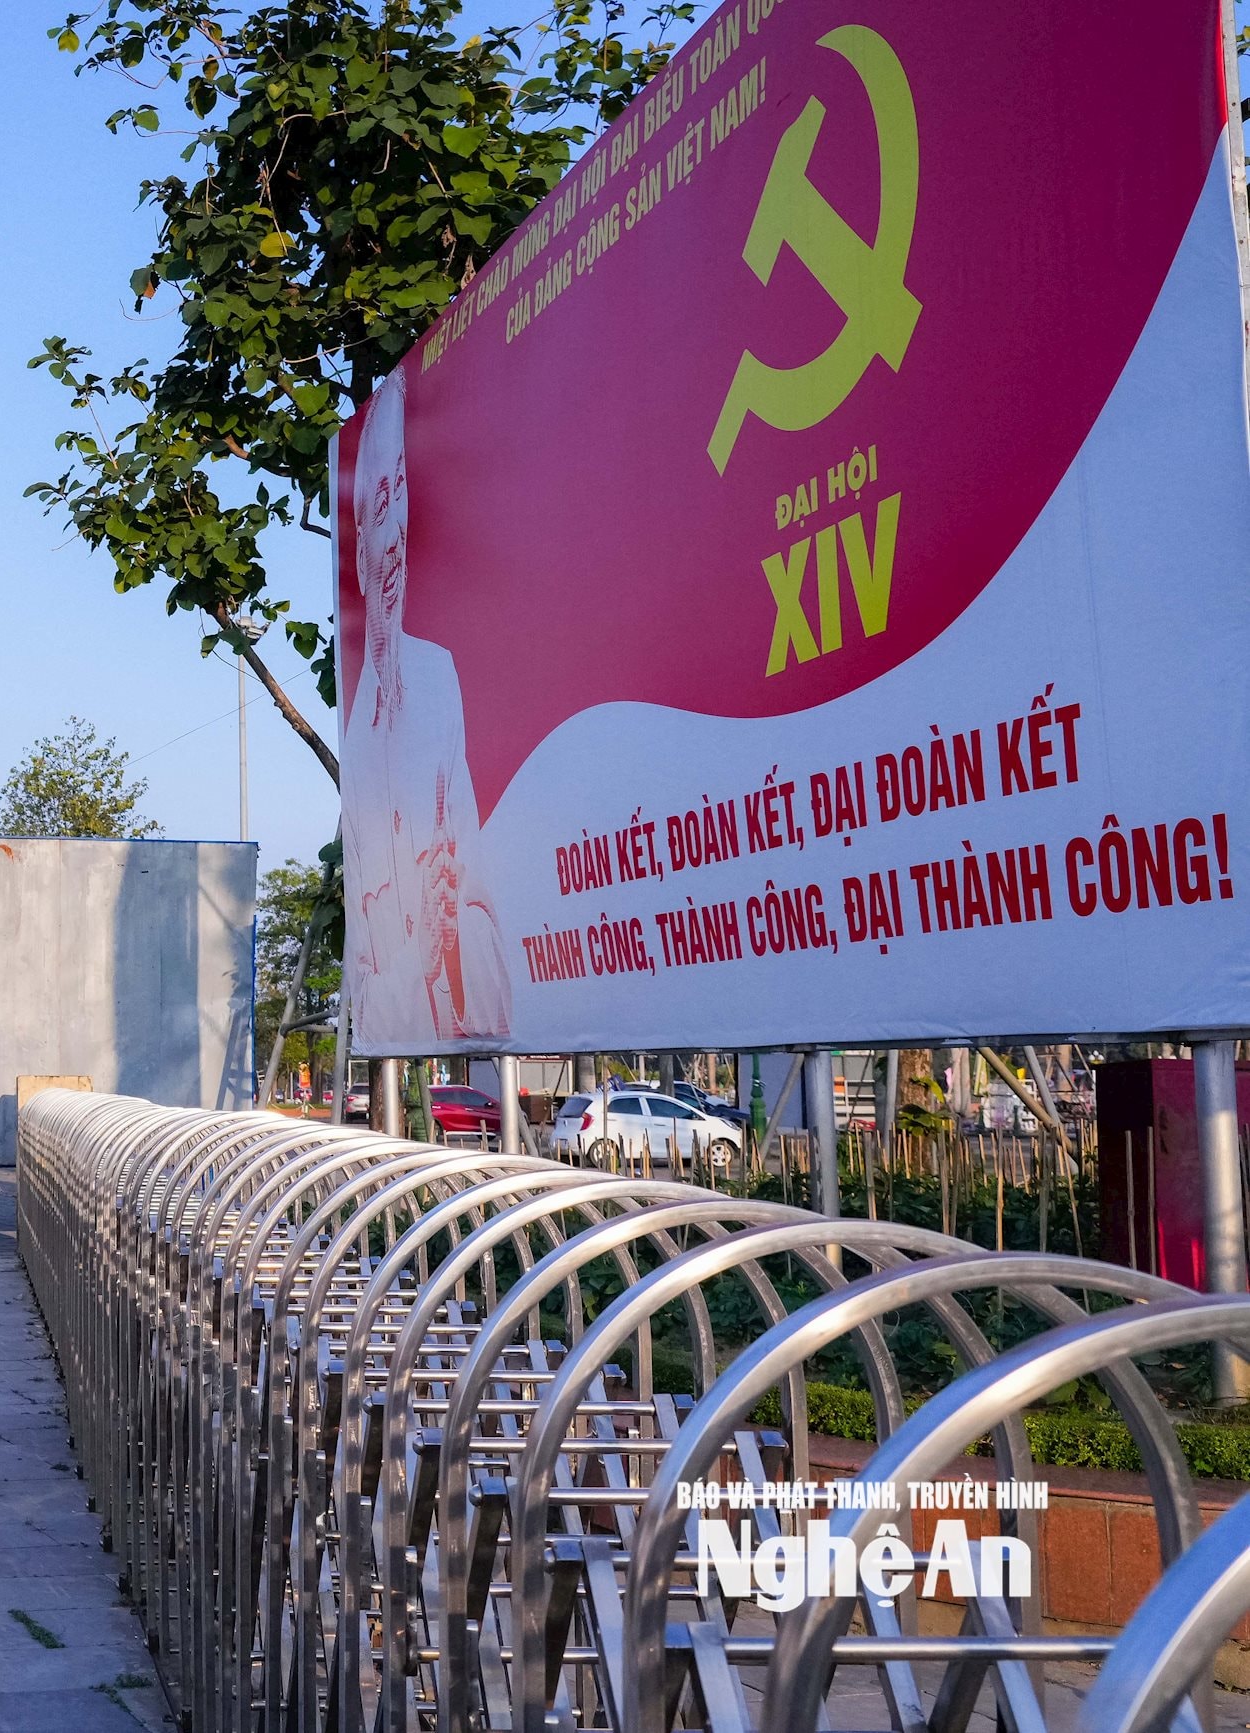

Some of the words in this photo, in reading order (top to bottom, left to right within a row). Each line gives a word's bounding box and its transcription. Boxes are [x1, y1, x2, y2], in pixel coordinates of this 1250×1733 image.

[421, 317, 453, 375] NHIỆT
[452, 289, 475, 343] LIỆT
[476, 255, 510, 317] CHÀO
[511, 210, 551, 281] MỪNG
[552, 179, 578, 238] ĐẠI
[580, 147, 607, 209] HỘI
[610, 112, 639, 178] ĐẠI
[643, 59, 684, 145] BIỂU
[689, 3, 741, 96] TOÀN
[505, 287, 531, 345] CỦA
[534, 248, 573, 318] ĐẢNG
[576, 202, 620, 276] CỘNG
[624, 160, 662, 231] SẢN
[666, 116, 705, 193] VIỆT
[710, 55, 767, 152] NAM!
[760, 491, 902, 678] XIV
[775, 476, 819, 531] ĐẠI
[827, 444, 878, 504] HỘI
[555, 828, 613, 896] ĐOÀN
[614, 806, 664, 882] KẾT,
[666, 793, 741, 873] ĐOÀN
[743, 764, 805, 854] KẾT,
[810, 761, 868, 847] ĐẠI
[875, 723, 986, 823] ĐOÀN
[997, 682, 1082, 797] KẾT
[521, 922, 587, 984] THÀNH
[587, 912, 656, 977] CÔNG,
[655, 895, 743, 968] THÀNH
[746, 879, 839, 957] CÔNG,
[842, 869, 904, 955] ĐẠI
[909, 839, 1053, 934] THÀNH
[1065, 813, 1234, 917] CÔNG!
